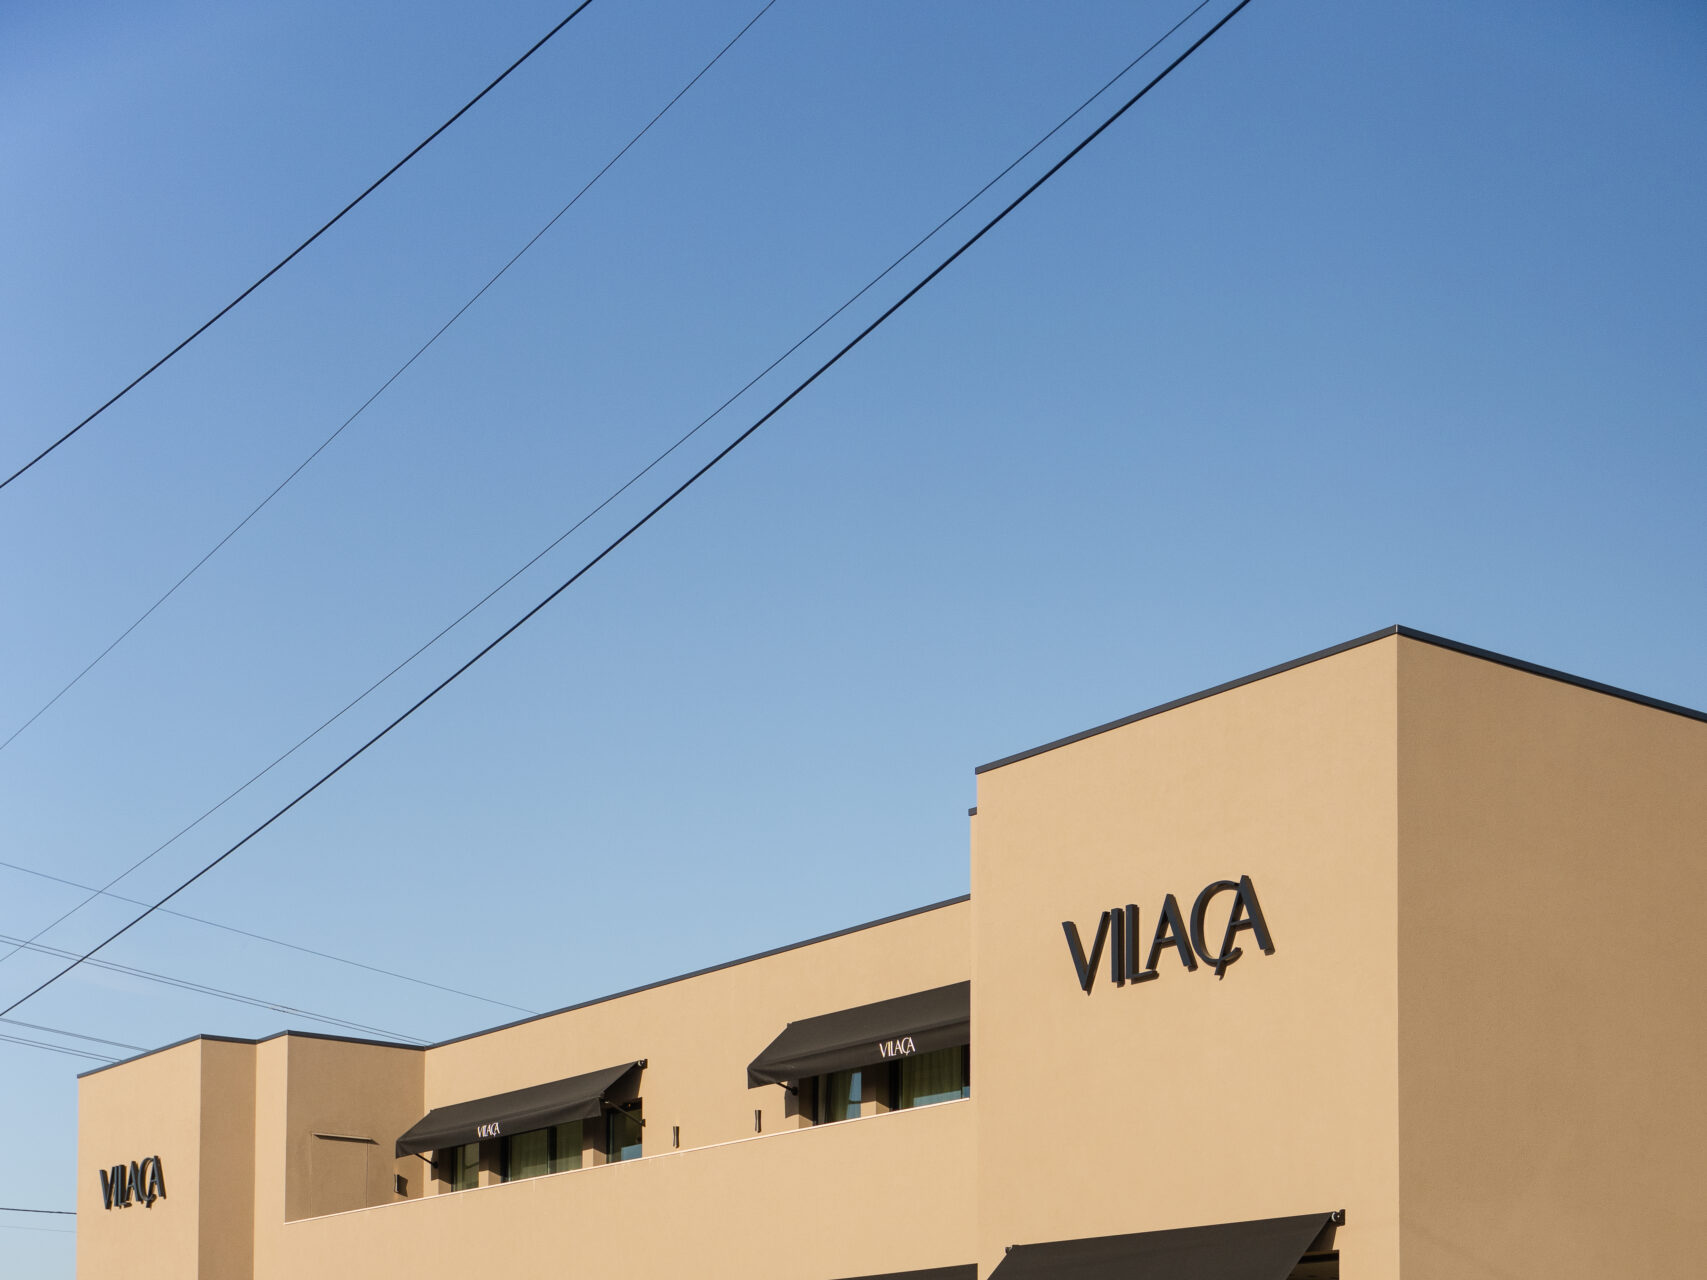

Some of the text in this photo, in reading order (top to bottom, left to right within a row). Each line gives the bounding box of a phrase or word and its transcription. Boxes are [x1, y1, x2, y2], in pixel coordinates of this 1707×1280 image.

[1061, 875, 1275, 996] VILAÇA
[878, 1036, 916, 1058] VILAÇA
[477, 1121, 501, 1138] VILAÇA
[99, 1155, 167, 1210] VILAÇA
